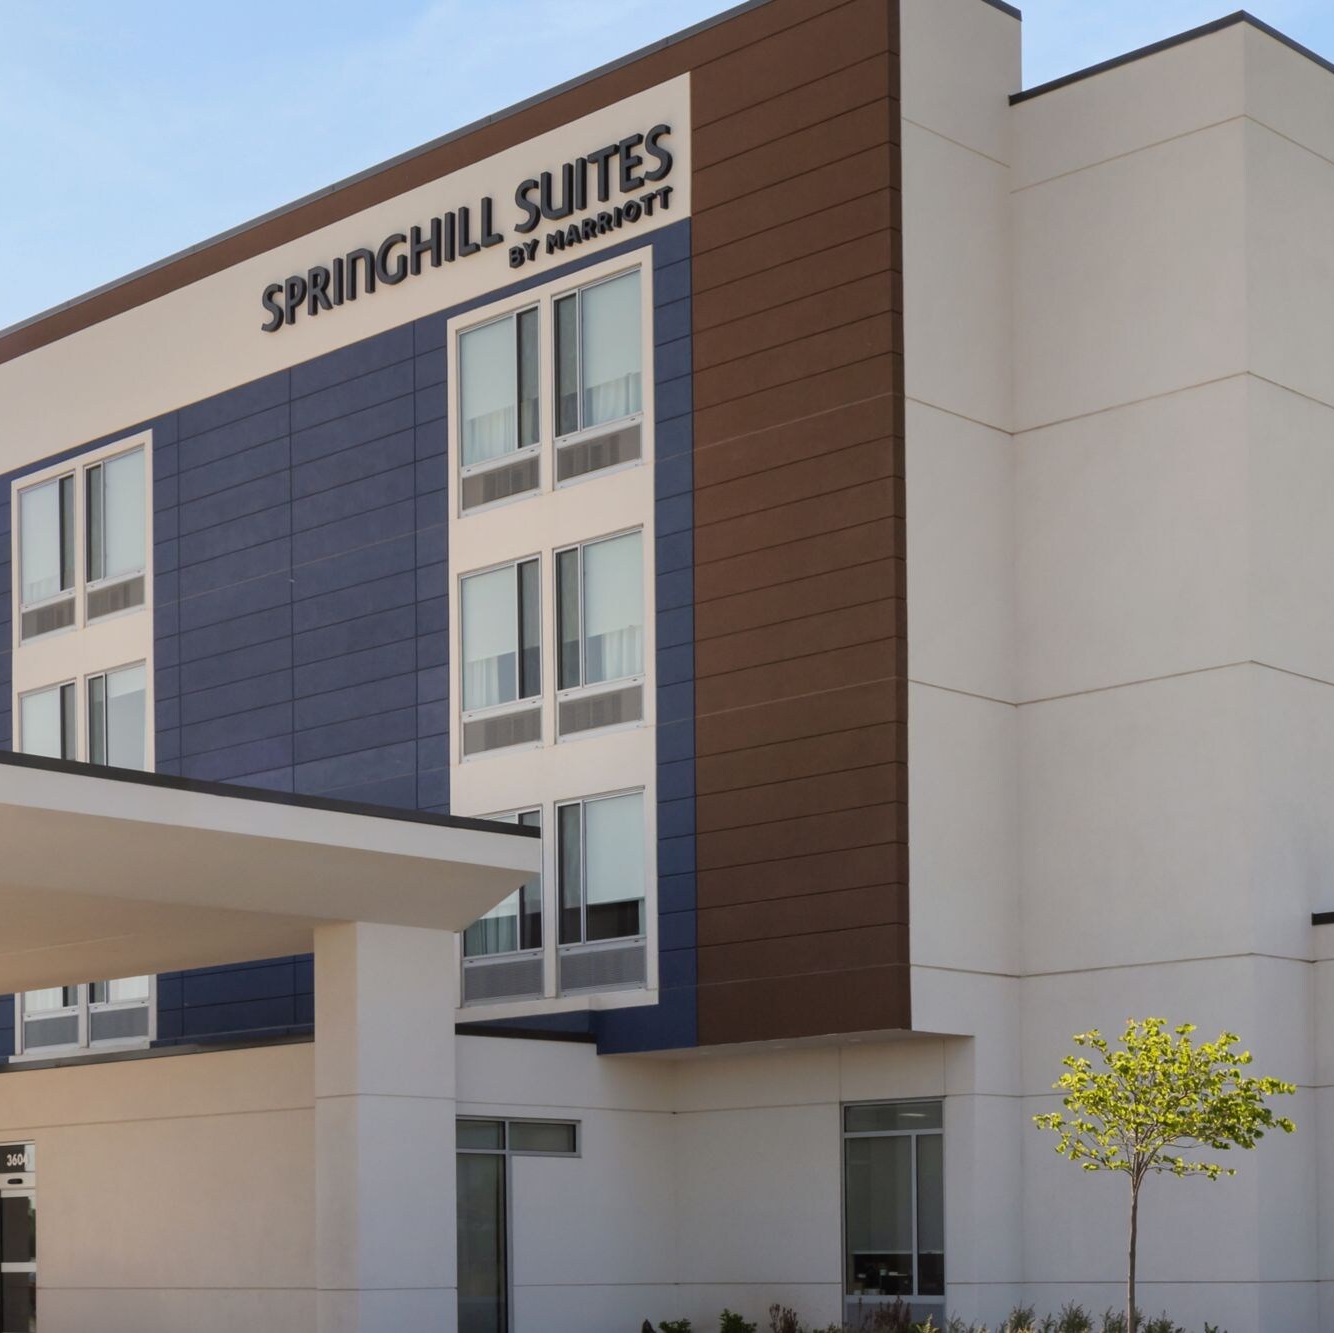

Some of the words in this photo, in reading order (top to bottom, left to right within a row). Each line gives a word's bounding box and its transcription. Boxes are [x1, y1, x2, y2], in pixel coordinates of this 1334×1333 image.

[261, 196, 503, 333] SPRINGHILL
[514, 124, 674, 234] SUITES
[509, 238, 540, 269] BY
[546, 185, 673, 255] MARRIOTT
